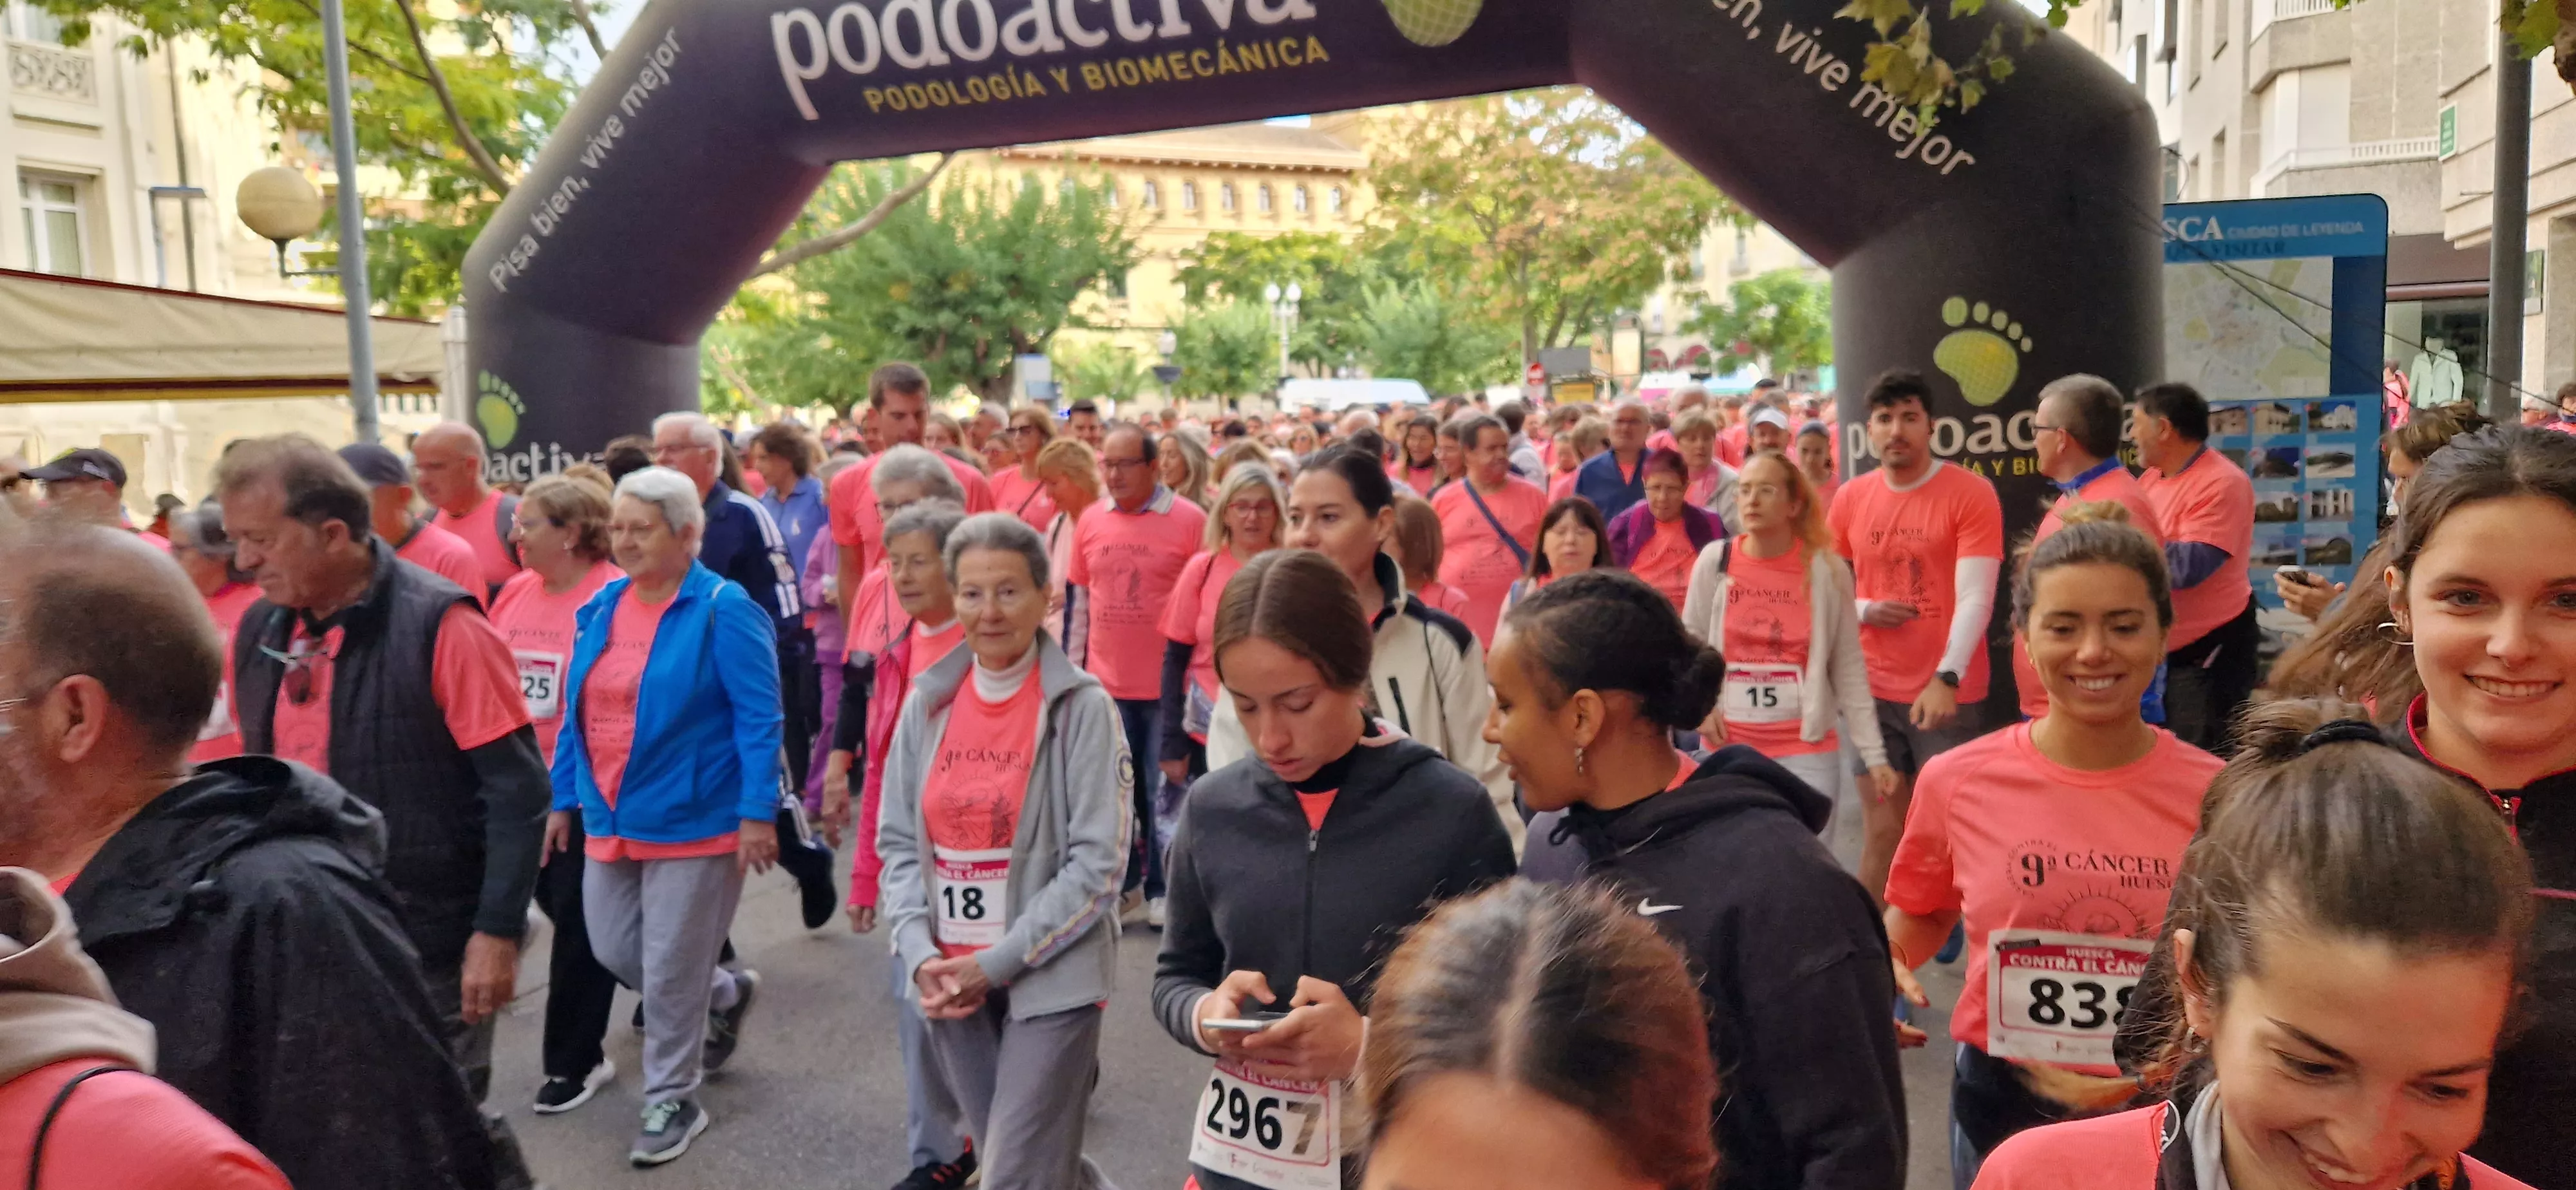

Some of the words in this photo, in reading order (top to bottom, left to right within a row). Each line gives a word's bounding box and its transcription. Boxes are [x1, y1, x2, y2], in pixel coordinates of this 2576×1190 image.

[863, 63, 1047, 113] PODOLOGÍA
[1049, 68, 1070, 93] Y
[1081, 33, 1330, 91] BIOMECÁNICA
[1776, 21, 1850, 91] vive
[1849, 82, 1976, 175] mejor
[488, 233, 540, 292] Pisa
[530, 175, 591, 237] bien,
[580, 113, 624, 169] vive
[620, 26, 682, 117] mejor
[2282, 223, 2300, 237] DE
[2303, 220, 2363, 236] LEYENDA
[1991, 458, 2005, 477] Y
[1746, 686, 1777, 707] 15
[2065, 848, 2169, 877] CÁNCER
[943, 886, 985, 920] 18
[2009, 953, 2078, 972] CONTRA
[2082, 961, 2100, 974] EL
[1208, 1078, 1320, 1155] 2967
